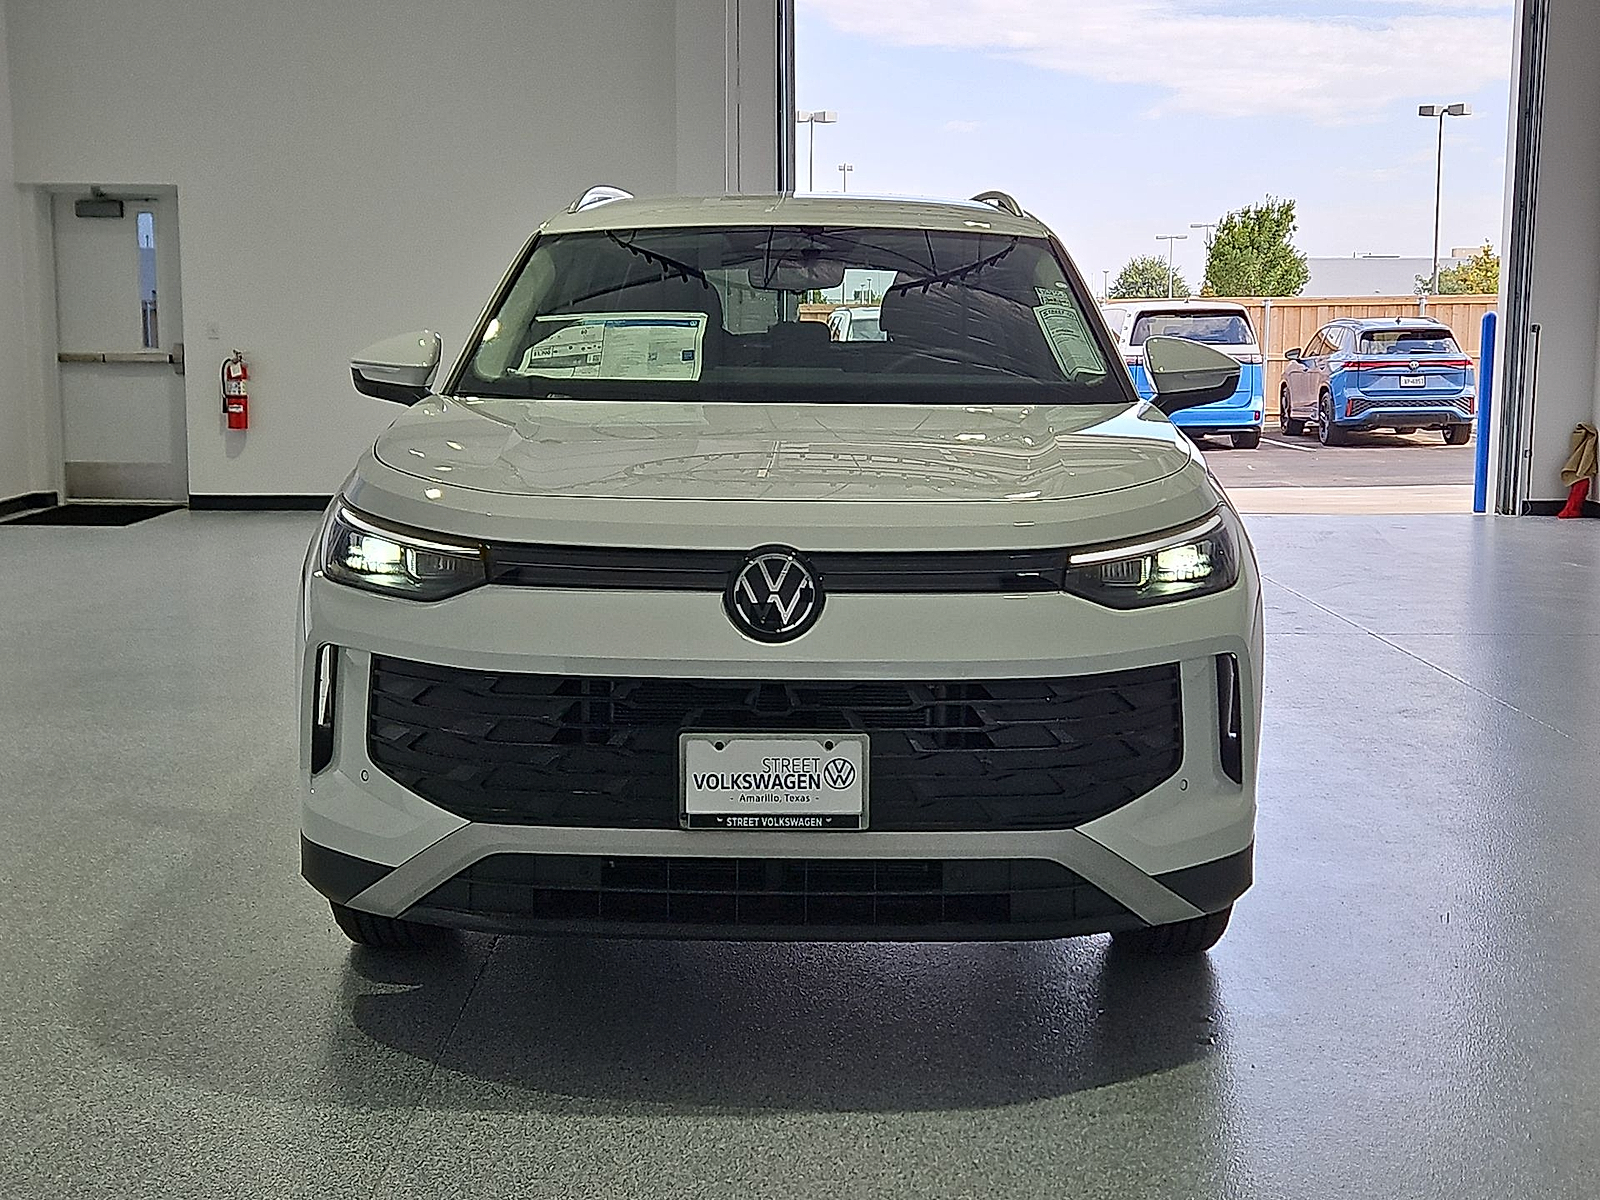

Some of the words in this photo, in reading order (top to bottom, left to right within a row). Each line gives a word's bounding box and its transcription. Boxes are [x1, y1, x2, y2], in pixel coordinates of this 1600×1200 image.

[762, 757, 820, 774] STREET
[693, 773, 821, 790] VOLKSWAGEN
[739, 793, 782, 803] Amarillo,
[784, 793, 811, 803] Texas
[726, 817, 760, 827] STREET
[761, 817, 823, 827] VOLKSWAGEN
